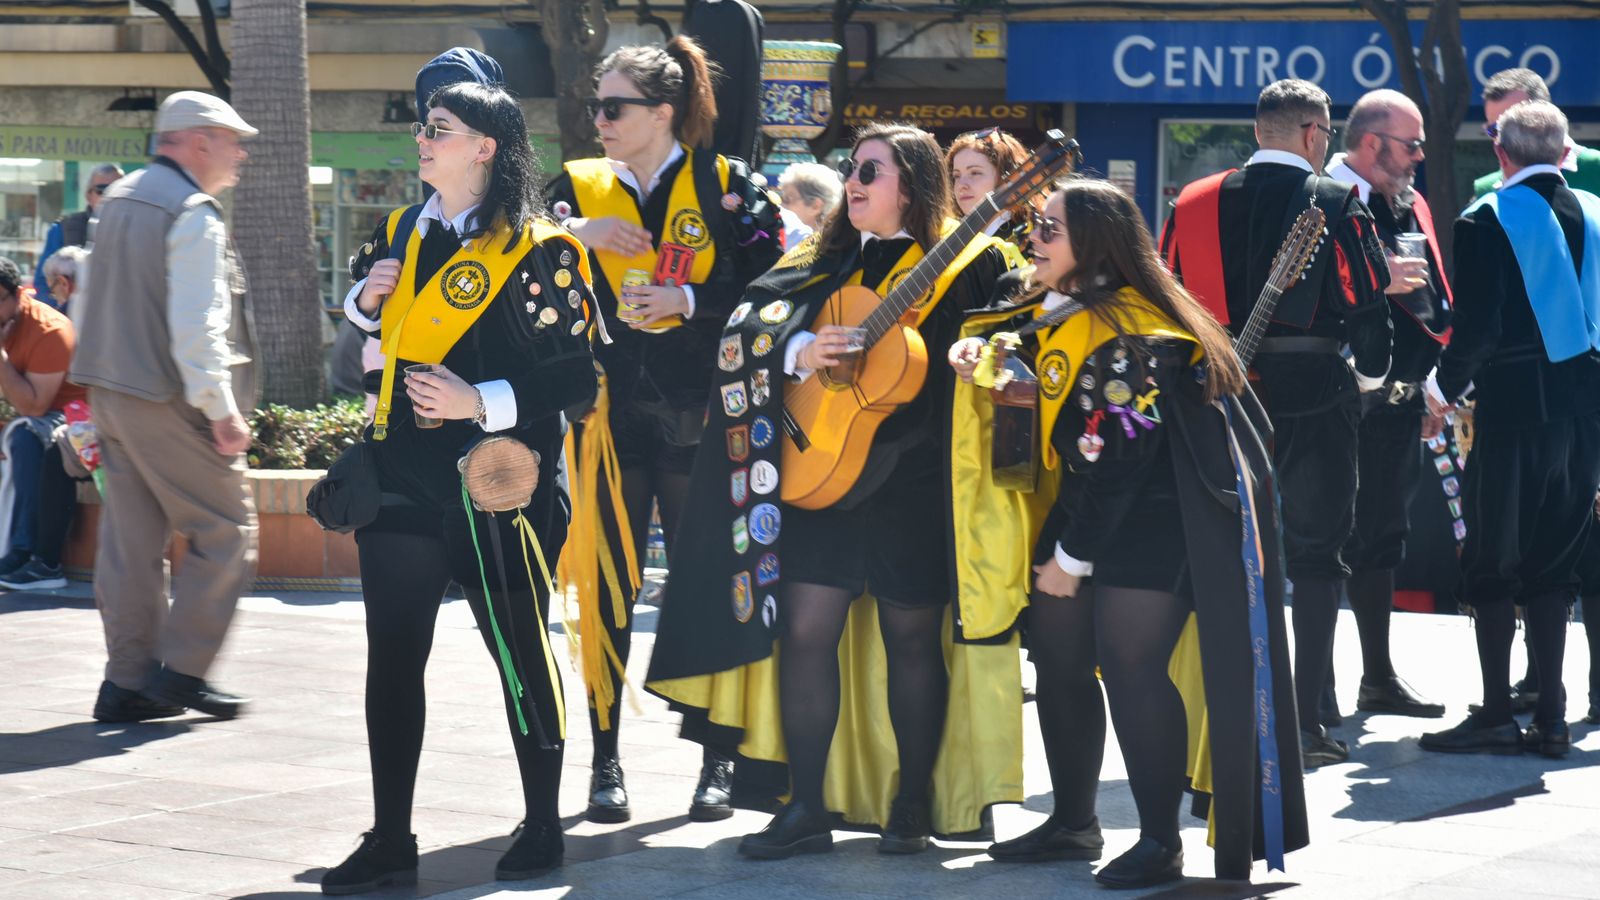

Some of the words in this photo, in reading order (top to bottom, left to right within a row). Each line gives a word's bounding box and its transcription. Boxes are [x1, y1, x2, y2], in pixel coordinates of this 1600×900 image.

[1113, 35, 1326, 88] CENTRO
[899, 104, 1028, 119] REGALOS
[13, 135, 59, 154] PARA
[64, 132, 143, 157] MÓVILES
